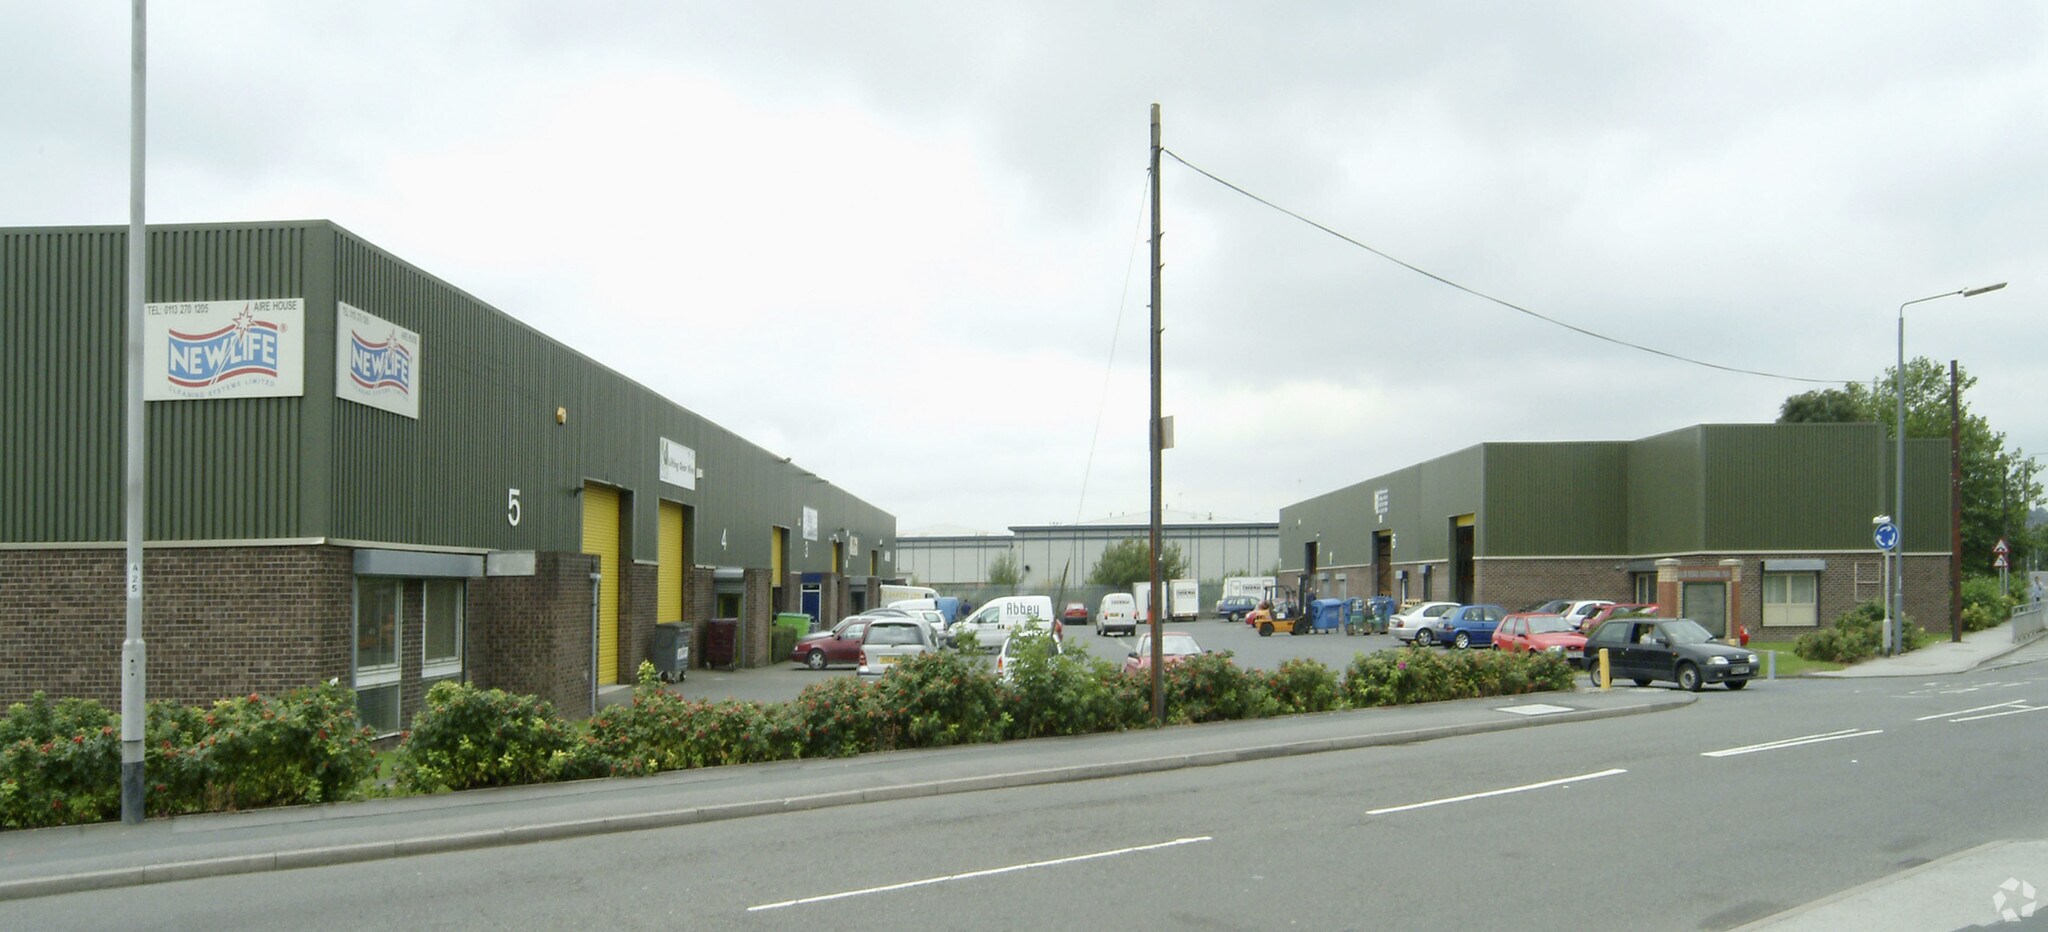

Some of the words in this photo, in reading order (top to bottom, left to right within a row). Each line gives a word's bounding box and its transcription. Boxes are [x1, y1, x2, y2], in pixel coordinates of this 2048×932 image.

[164, 305, 177, 314] 0113
[180, 304, 192, 314] 270
[194, 303, 209, 314] 1205
[254, 301, 270, 312] AIRE
[272, 300, 297, 311] HOUSE
[168, 385, 204, 398] CLEANING
[245, 378, 275, 388] LIMITED
[508, 488, 520, 526] 5
[721, 528, 727, 551] 4
[1006, 602, 1040, 617] Abbey
